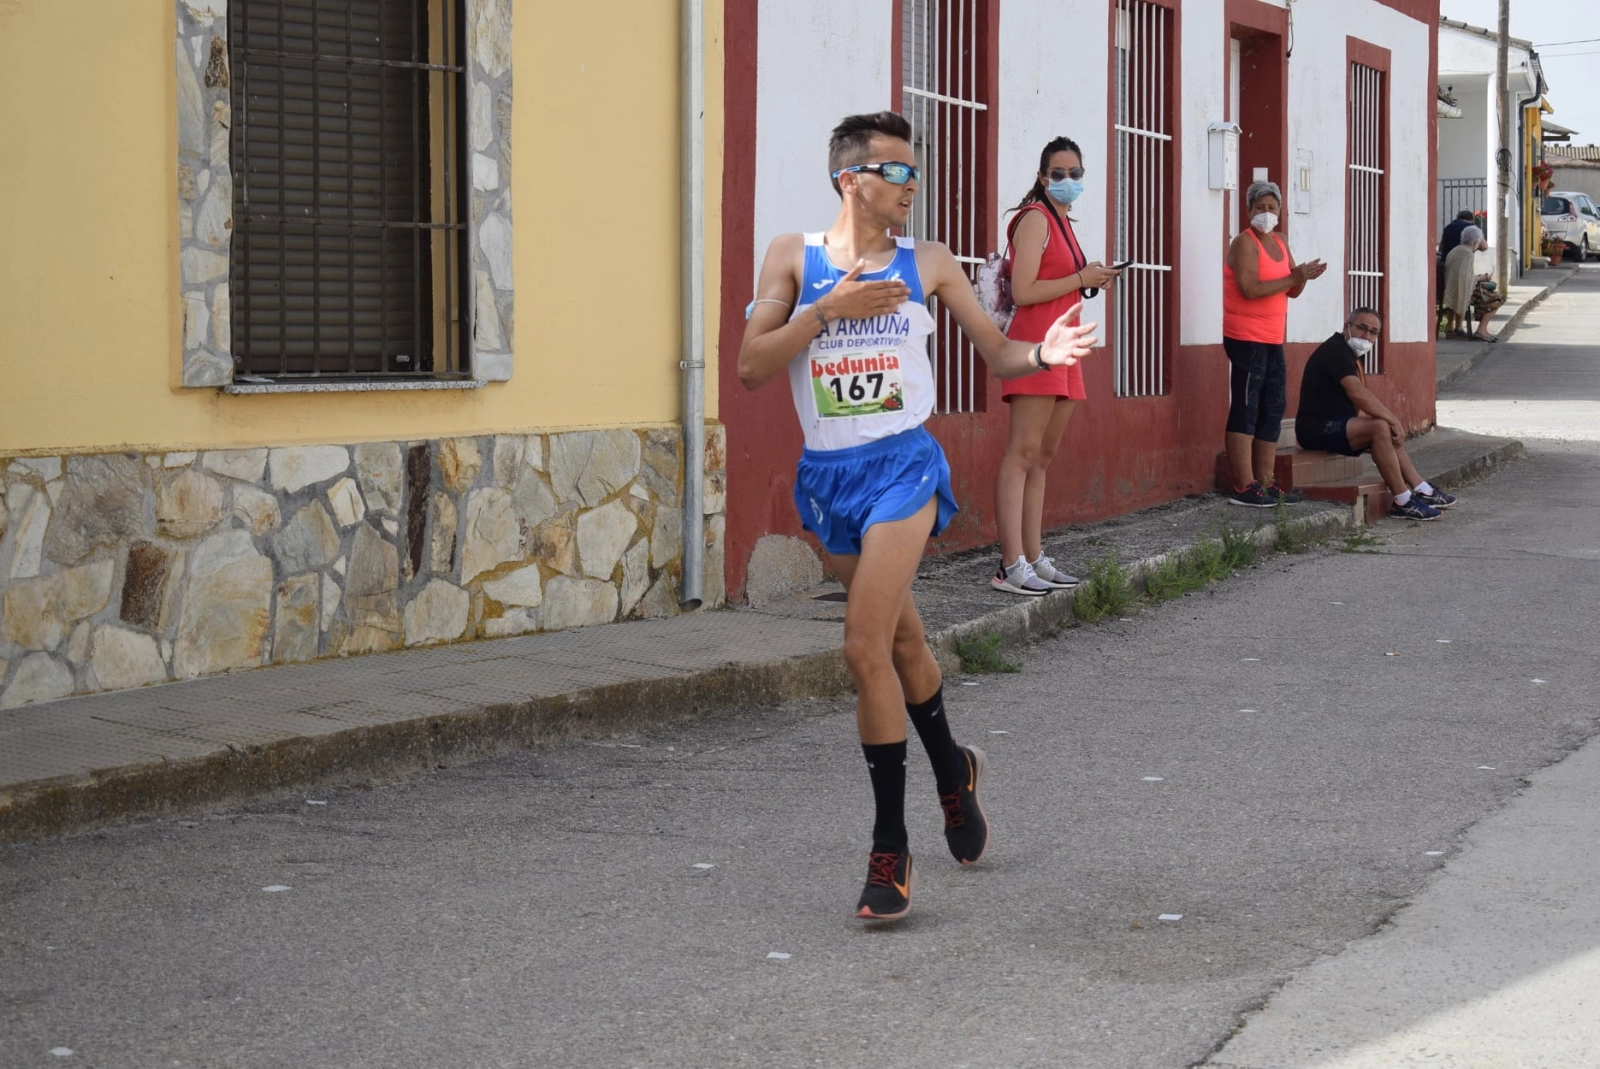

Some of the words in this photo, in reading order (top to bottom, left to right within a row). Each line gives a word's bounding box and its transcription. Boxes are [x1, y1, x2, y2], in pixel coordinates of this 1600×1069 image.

[814, 324, 830, 338] A
[836, 311, 910, 337] ARMUÑA
[818, 339, 843, 350] CLUB
[847, 337, 902, 348] DEPORTIVO
[811, 354, 899, 378] bedunia
[830, 373, 884, 402] 167
